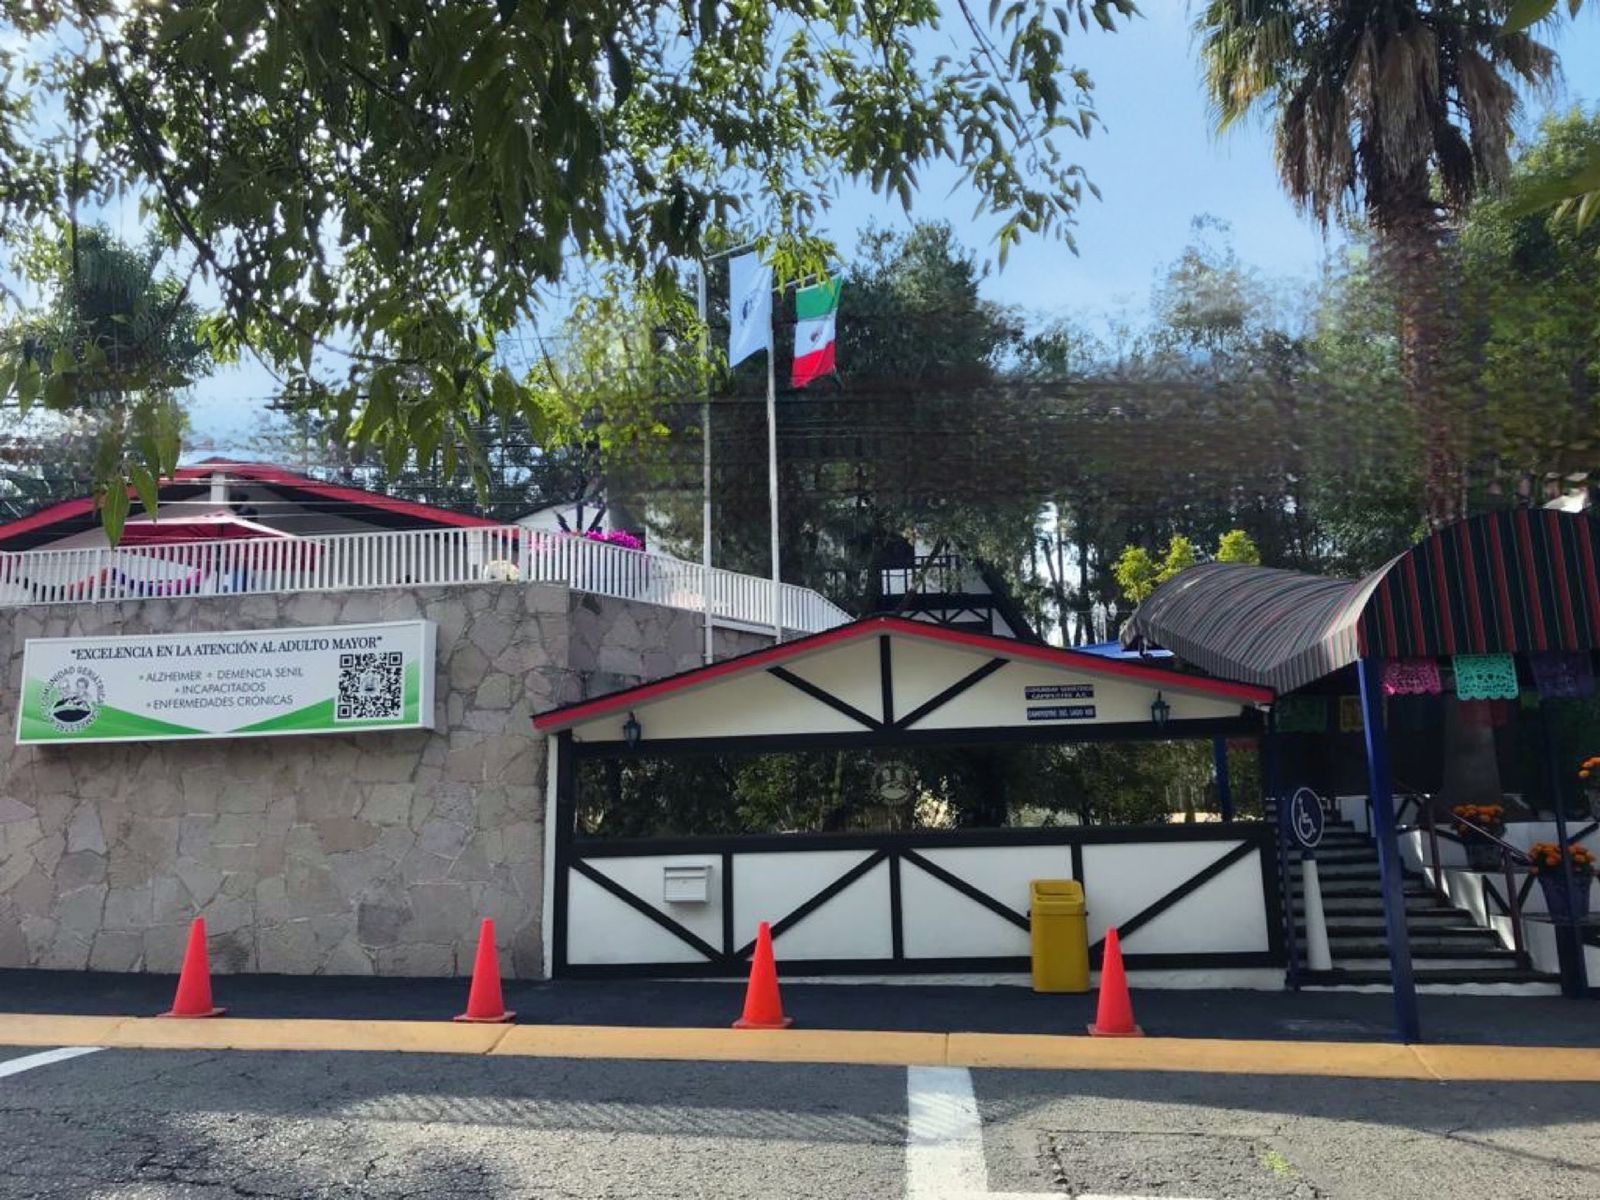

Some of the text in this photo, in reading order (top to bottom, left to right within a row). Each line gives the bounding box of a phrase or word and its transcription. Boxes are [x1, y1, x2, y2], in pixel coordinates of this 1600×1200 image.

[156, 645, 173, 657] EN
[176, 645, 193, 657] LA
[193, 640, 259, 656] ATENCIÓN
[259, 641, 275, 653] AL
[277, 638, 329, 652] ADULTO
[145, 667, 303, 682] ALZHEIMER DEMENCIA SENIL
[182, 682, 266, 694] INCAPACITADOS
[153, 697, 234, 710] ENFERMEDADES
